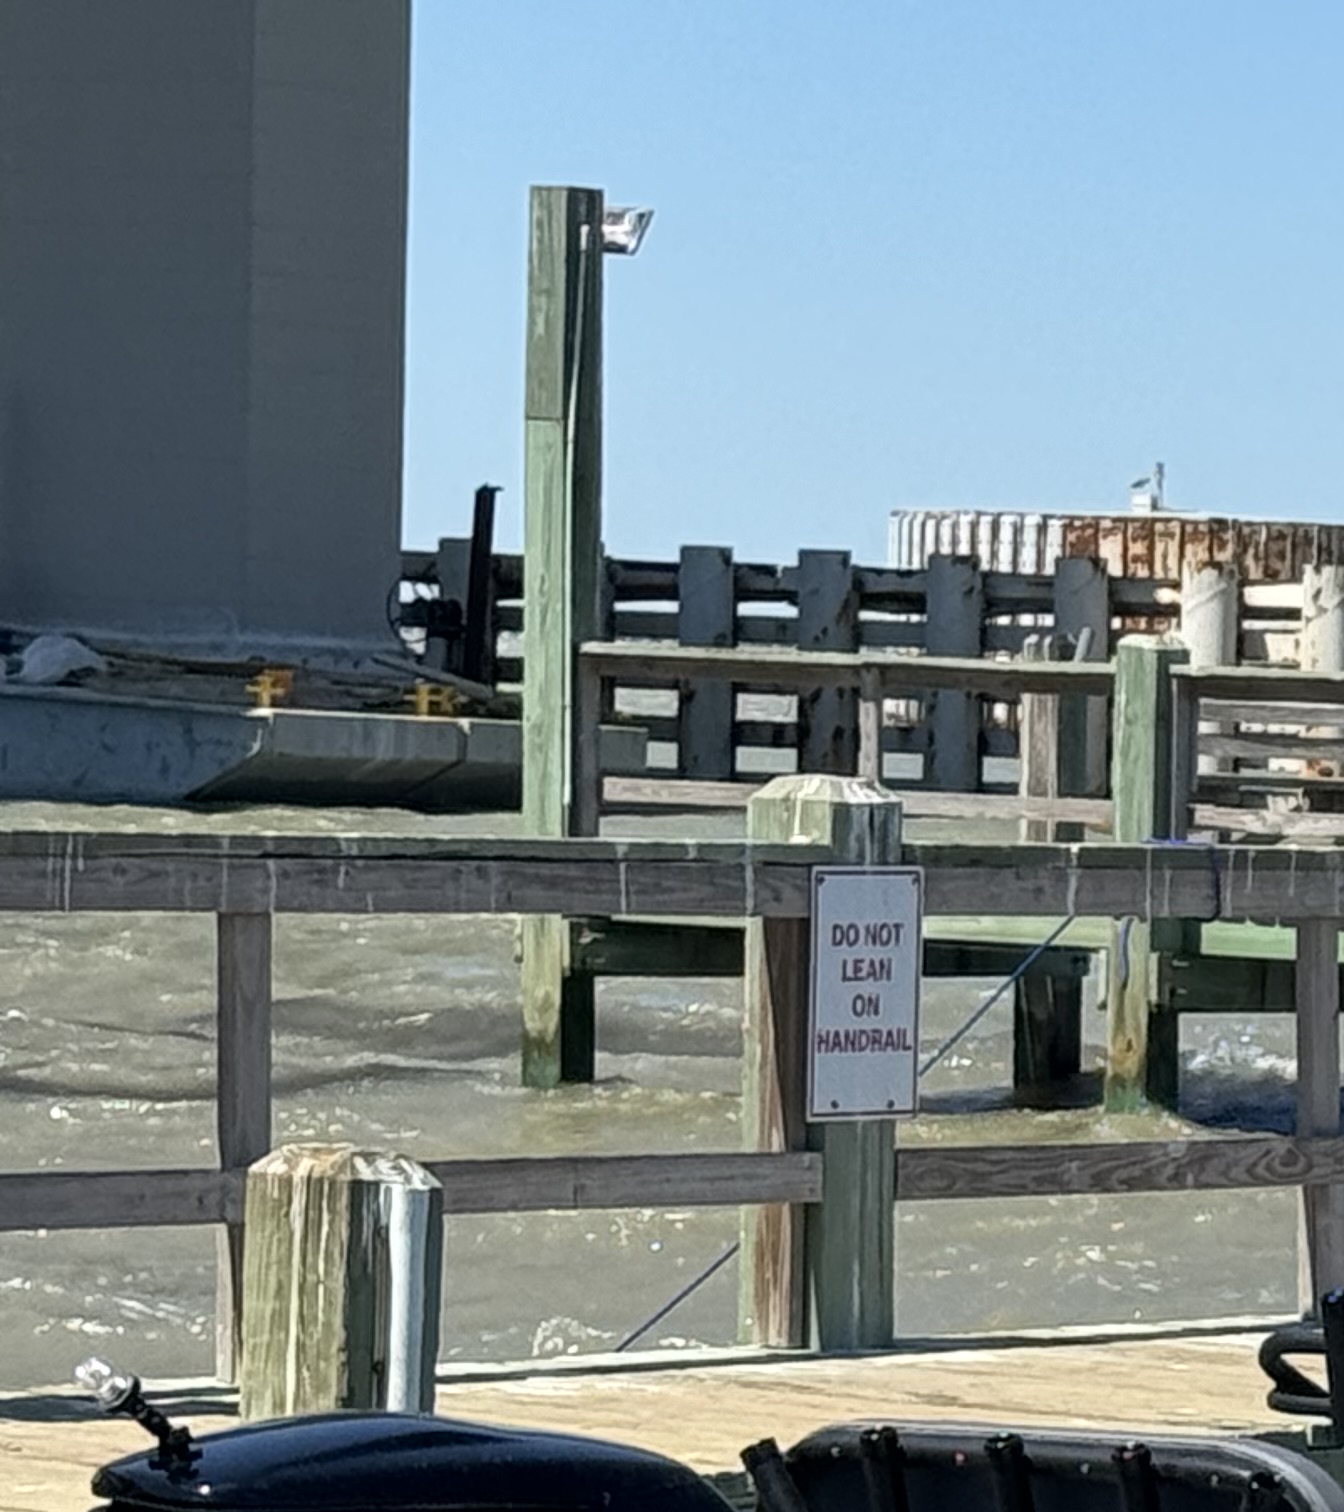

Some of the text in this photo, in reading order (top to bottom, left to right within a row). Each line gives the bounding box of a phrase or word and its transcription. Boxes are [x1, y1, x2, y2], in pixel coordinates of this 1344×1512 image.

[831, 922, 904, 947] DO NOT
[841, 957, 893, 983] LEAN
[851, 993, 881, 1018] ON
[817, 1027, 913, 1054] HANDRAIL
